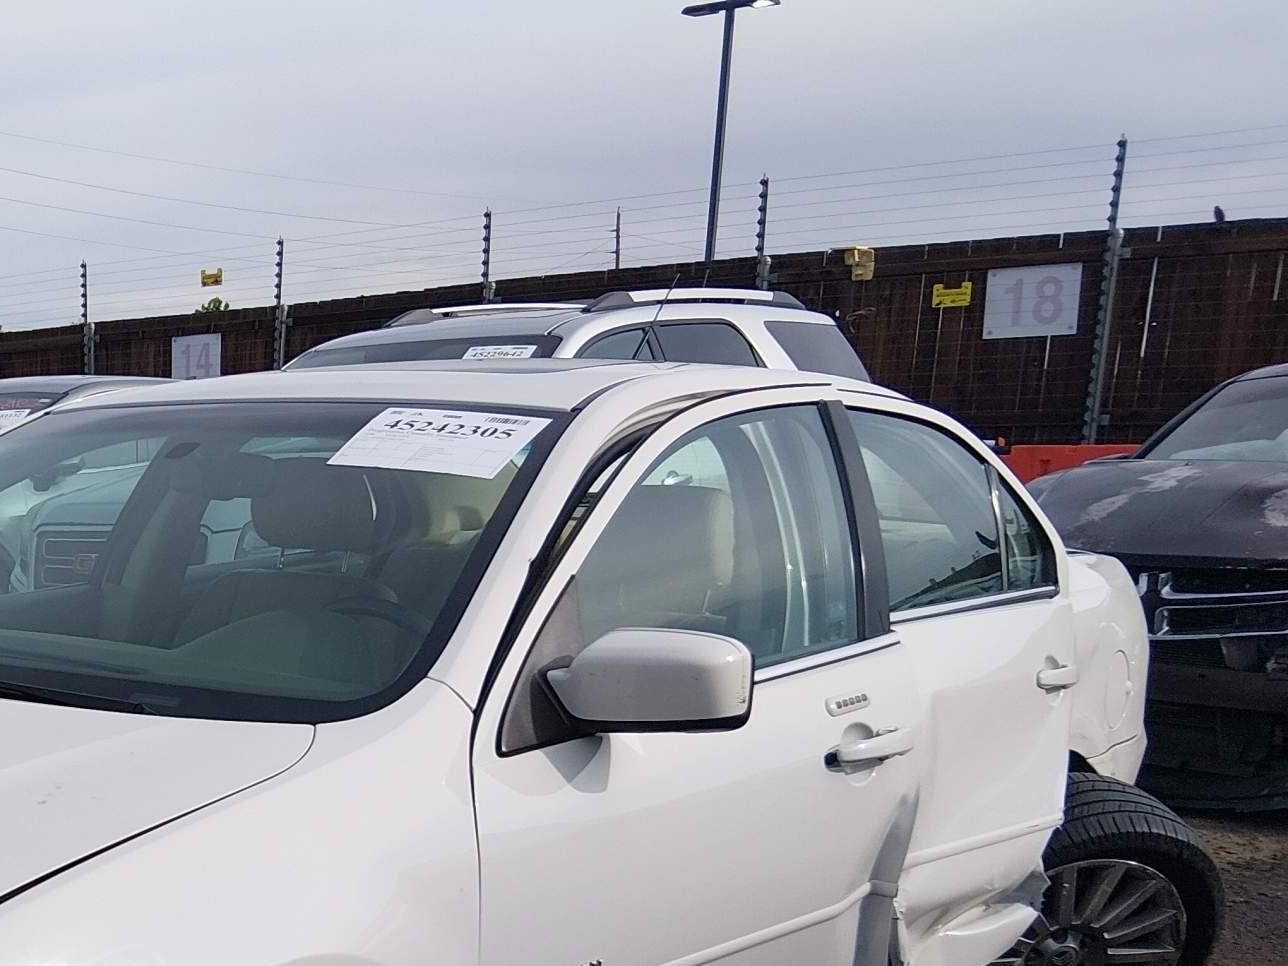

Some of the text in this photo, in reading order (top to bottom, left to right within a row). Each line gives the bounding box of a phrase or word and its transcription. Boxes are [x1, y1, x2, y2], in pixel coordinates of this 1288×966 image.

[1004, 276, 1062, 326] 18
[182, 343, 213, 378] 14
[384, 419, 518, 440] 45242305
